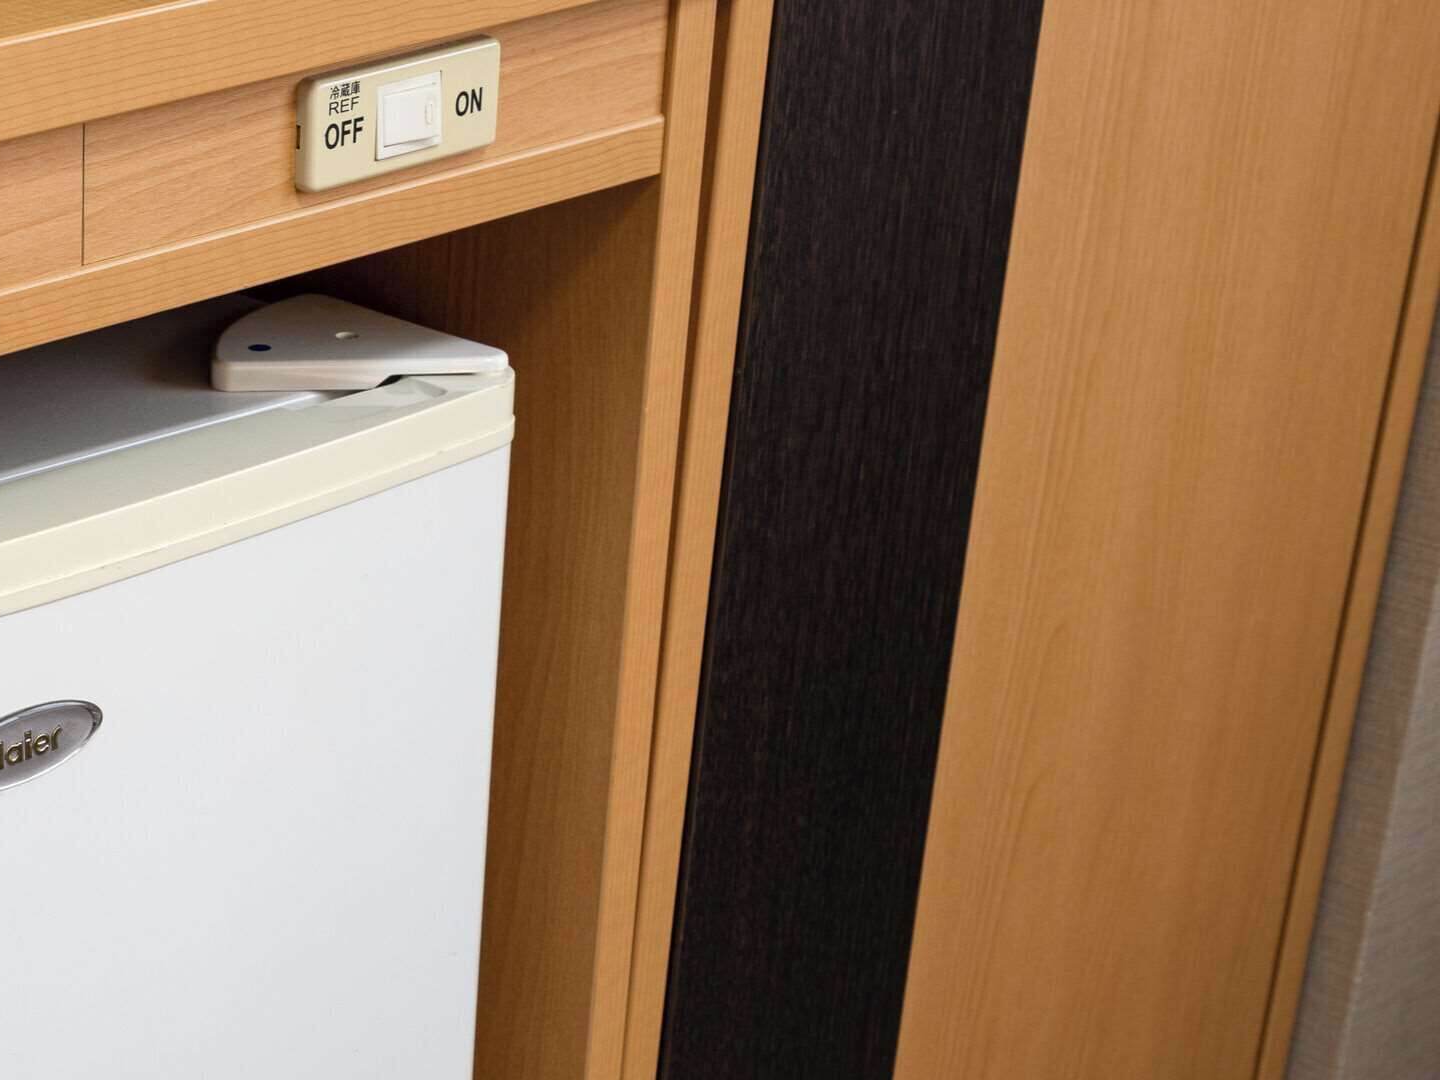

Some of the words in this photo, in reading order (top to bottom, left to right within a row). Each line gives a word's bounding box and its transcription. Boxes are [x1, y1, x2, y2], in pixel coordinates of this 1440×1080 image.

[330, 80, 361, 99] 冷蔵庫
[455, 87, 483, 116] ON
[328, 96, 360, 116] REF
[325, 116, 364, 150] OFF
